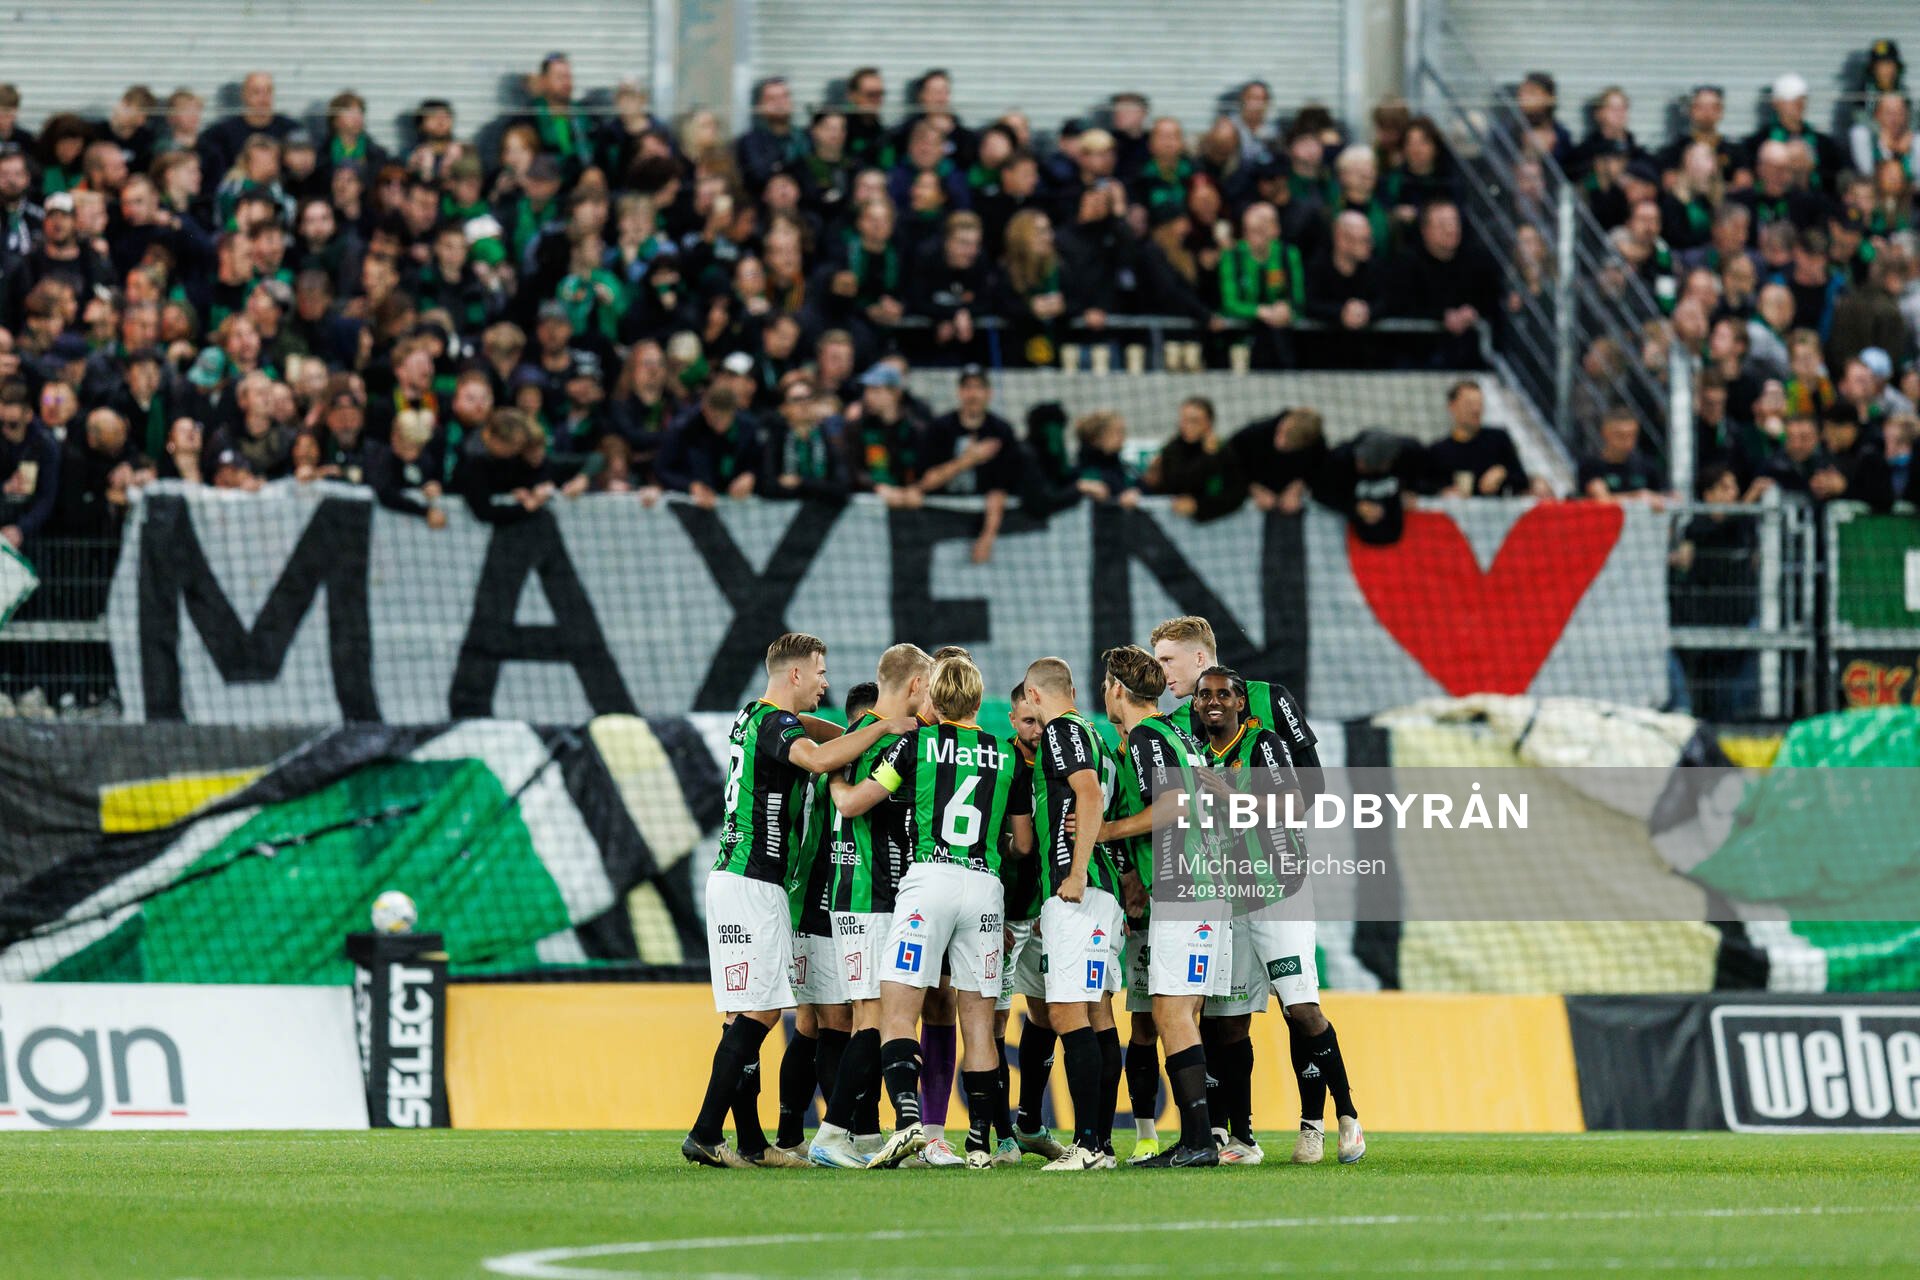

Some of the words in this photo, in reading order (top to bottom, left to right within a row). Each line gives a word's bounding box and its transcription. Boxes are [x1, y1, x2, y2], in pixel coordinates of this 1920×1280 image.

[138, 494, 1308, 722] MAXEN
[1068, 723, 1086, 763] stadium
[1278, 697, 1306, 743] stadium
[888, 737, 908, 767] dium
[926, 737, 1009, 771] Mattr
[1047, 725, 1067, 771] stadium
[1131, 744, 1147, 792] stadium
[1150, 739, 1168, 785] stadium
[1260, 741, 1285, 786] stadium
[941, 775, 982, 847] 6
[839, 925, 866, 936] VICE
[387, 962, 434, 1127] SELECT
[1738, 1011, 1920, 1119] webe
